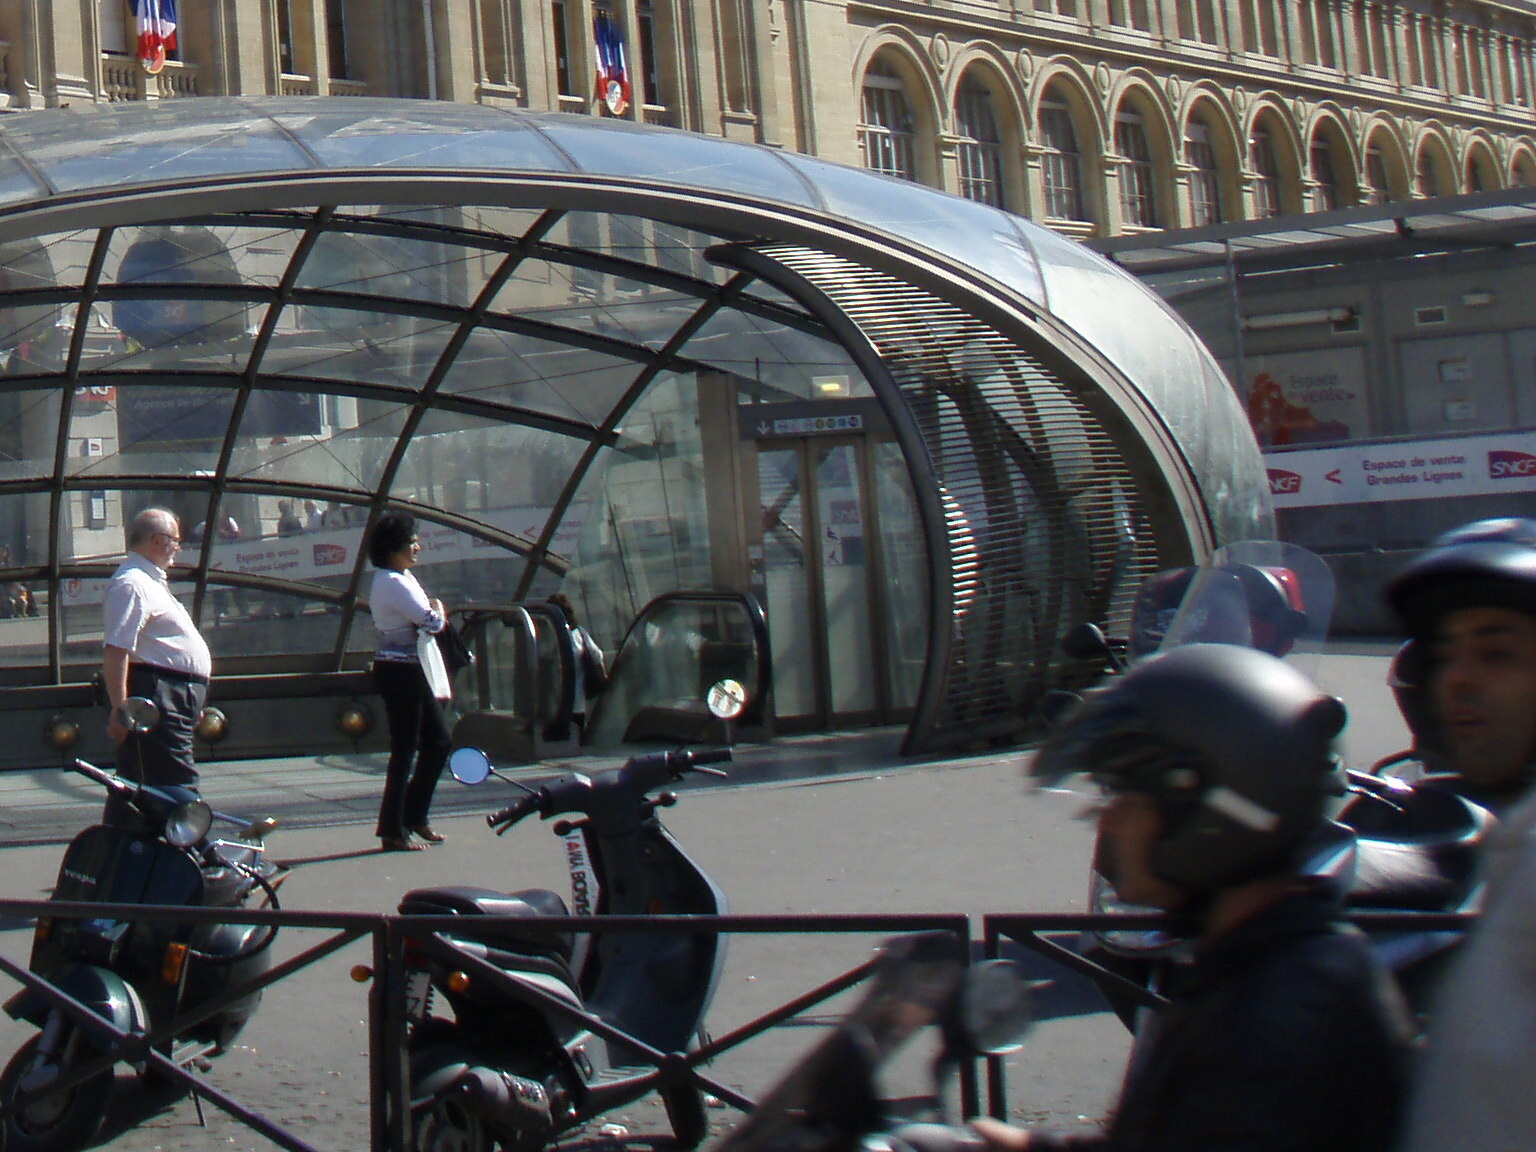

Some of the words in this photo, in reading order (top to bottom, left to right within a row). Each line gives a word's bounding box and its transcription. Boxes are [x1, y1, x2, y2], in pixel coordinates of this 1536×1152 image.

[1363, 459, 1407, 472] Espace
[1410, 456, 1425, 467] de
[1429, 454, 1465, 466] vente
[1492, 460, 1535, 477] SNCF
[1268, 479, 1298, 491] NCF
[1367, 473, 1418, 486] Grandes
[1423, 469, 1463, 484] Lignes
